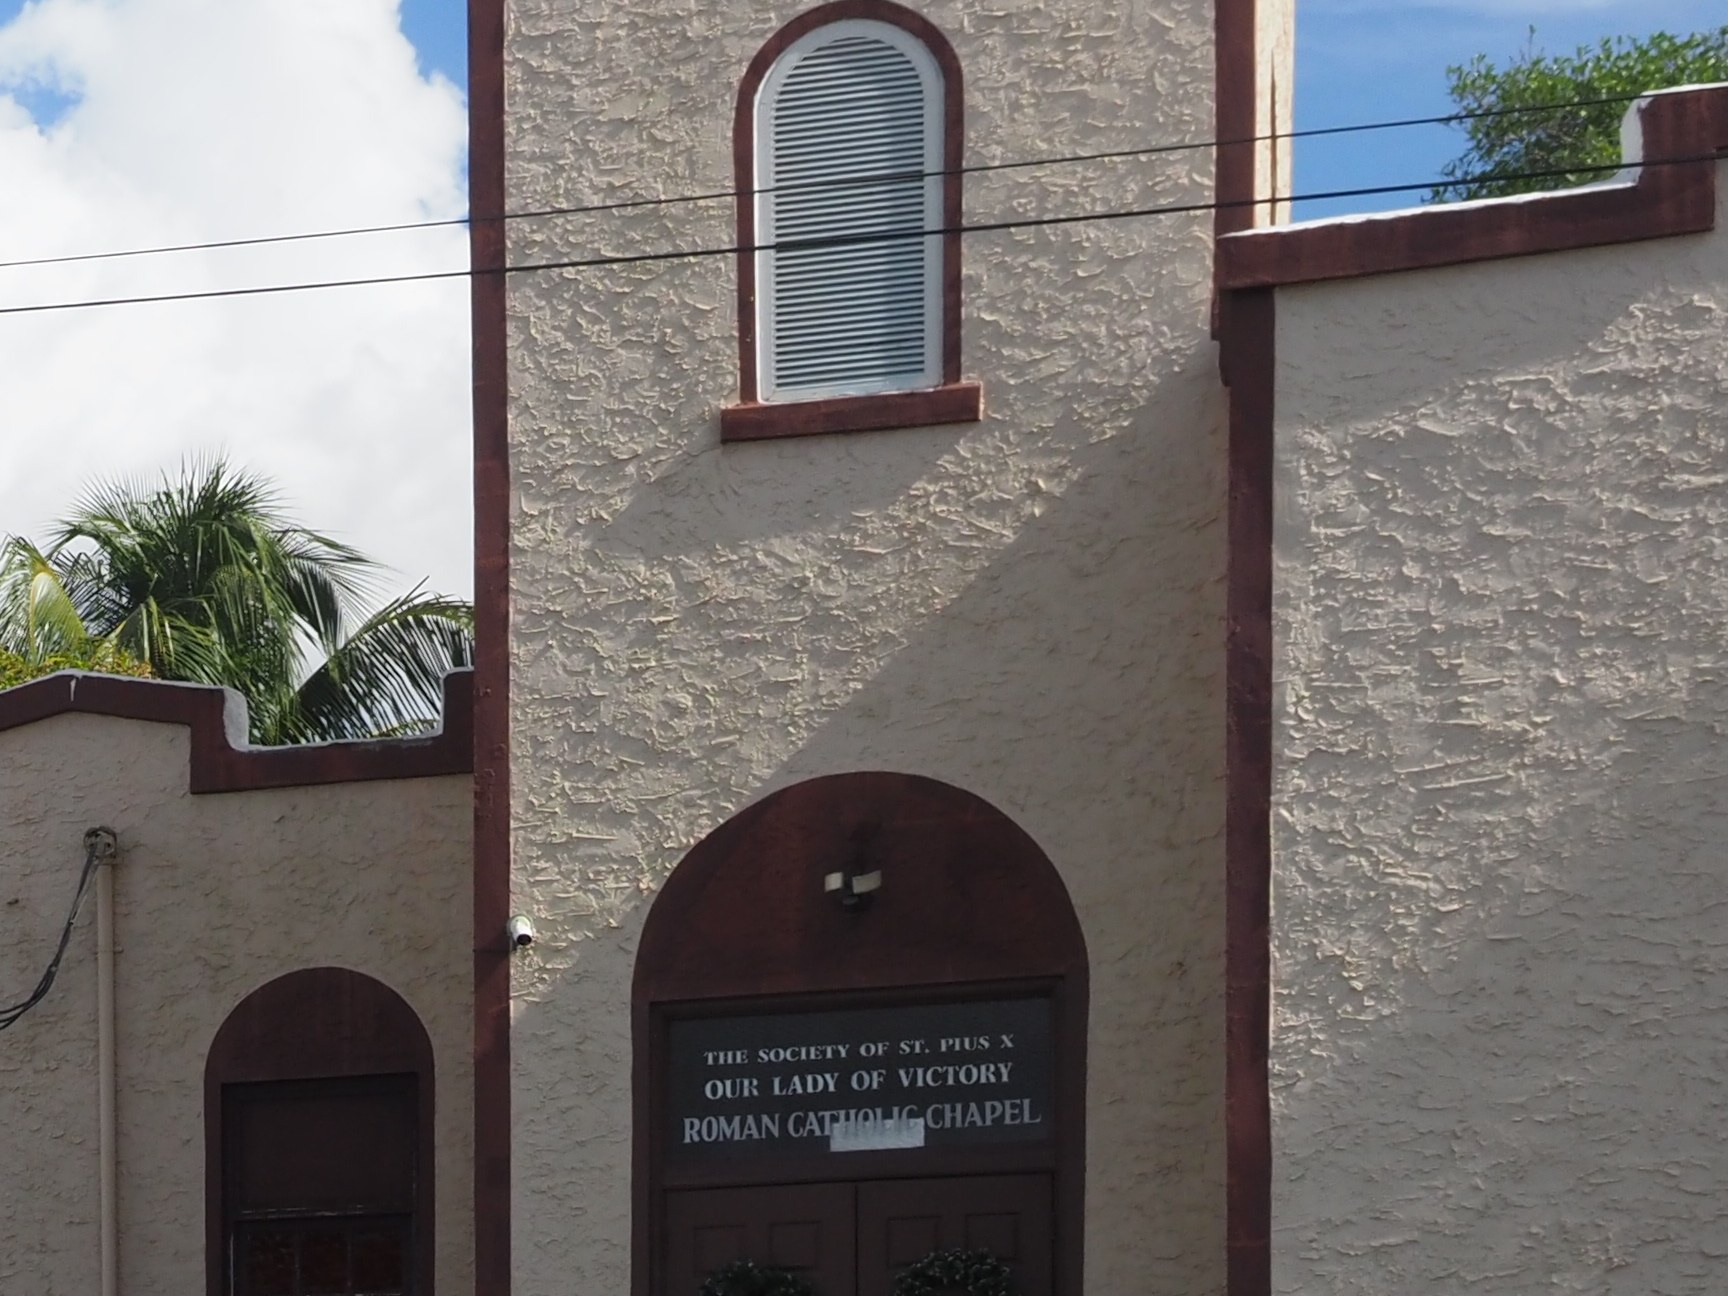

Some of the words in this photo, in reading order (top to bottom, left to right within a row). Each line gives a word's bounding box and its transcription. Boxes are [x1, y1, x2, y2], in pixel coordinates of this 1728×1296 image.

[703, 1049, 749, 1066] THE
[757, 1044, 850, 1064] SOCIETY
[859, 1041, 889, 1058] OF
[899, 1038, 930, 1056] ST.
[939, 1034, 991, 1053] PIUS
[999, 1033, 1016, 1049] X
[704, 1076, 760, 1100] OUR
[772, 1071, 840, 1097] LADY
[850, 1068, 887, 1091] OF
[898, 1061, 1014, 1088] VICTORY
[682, 1113, 781, 1144] ROMAN
[925, 1098, 1042, 1130] CHAPEL
